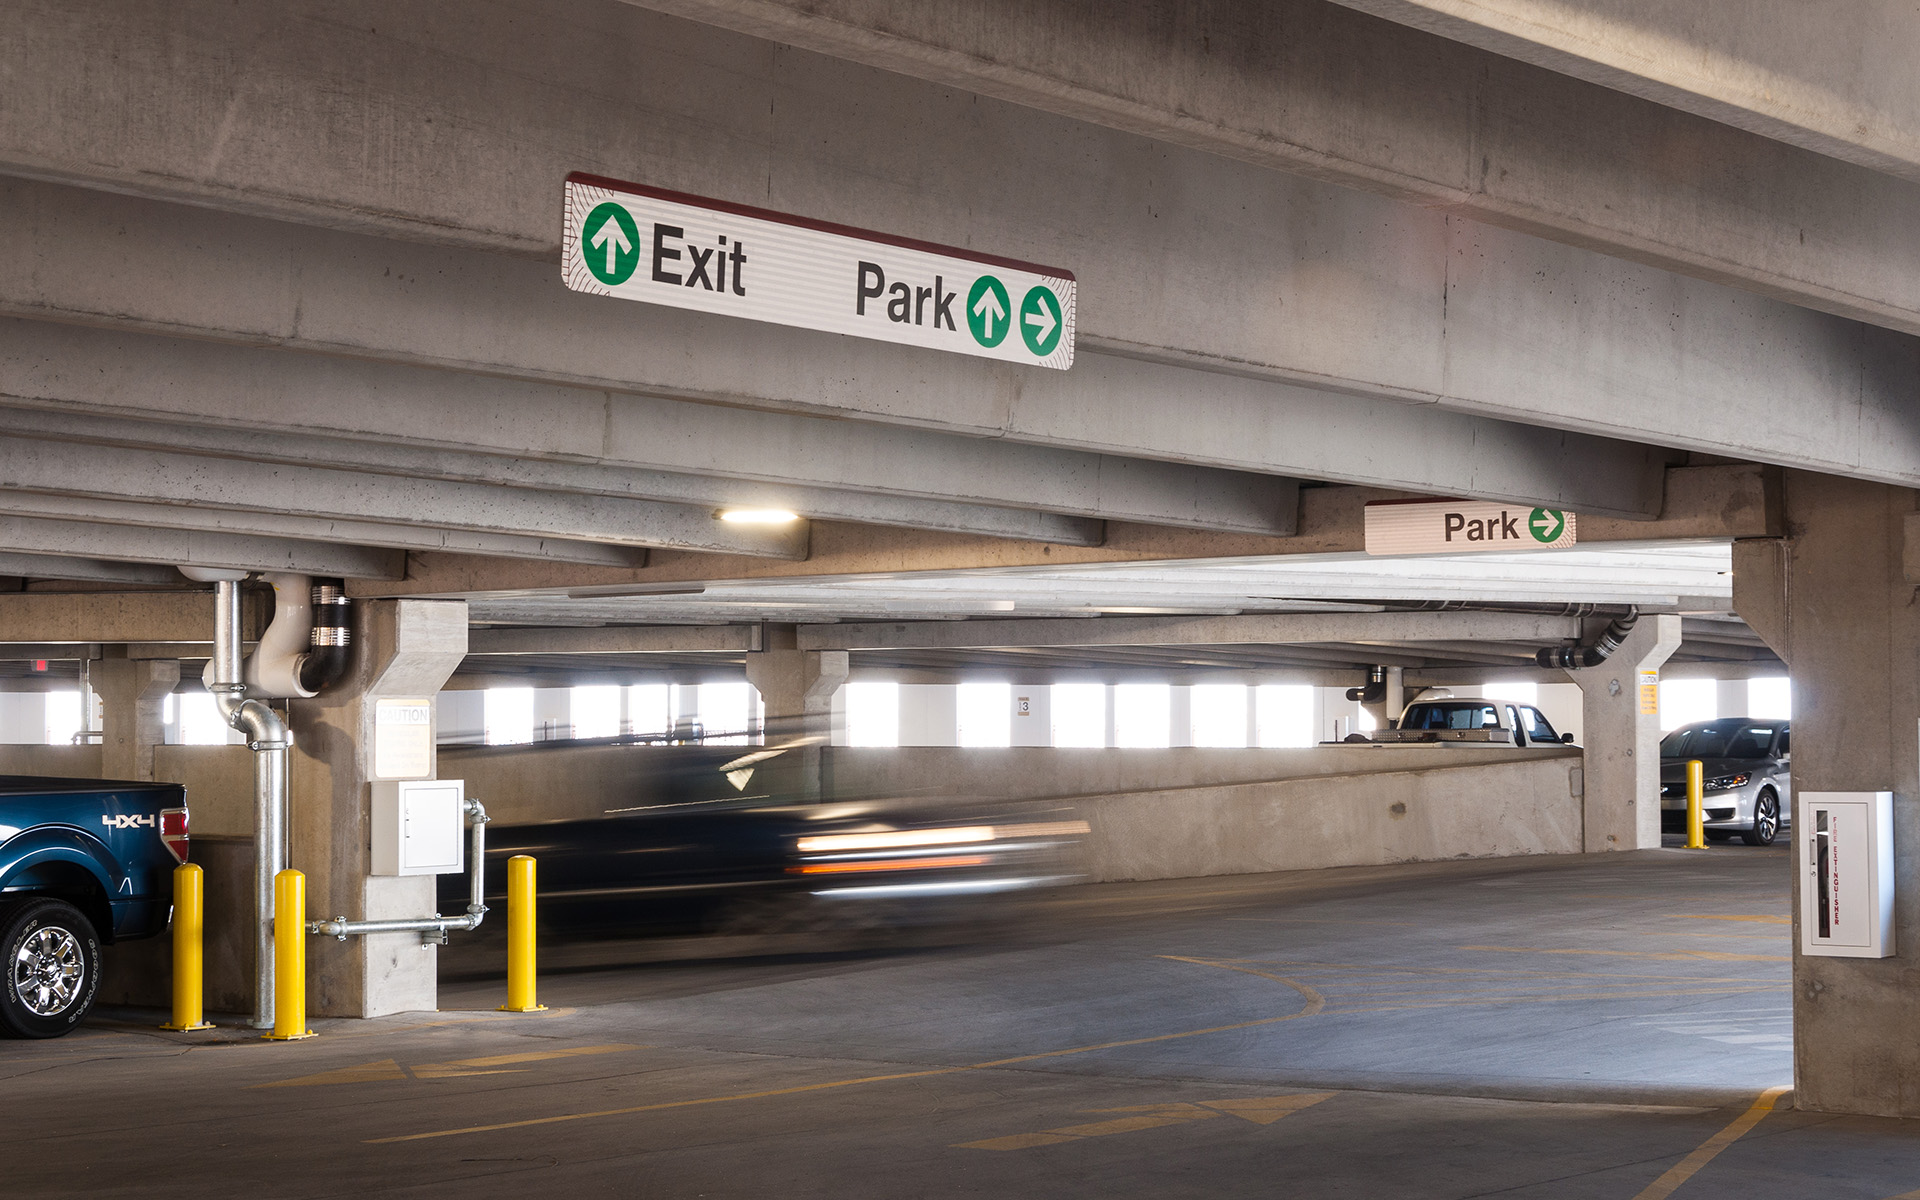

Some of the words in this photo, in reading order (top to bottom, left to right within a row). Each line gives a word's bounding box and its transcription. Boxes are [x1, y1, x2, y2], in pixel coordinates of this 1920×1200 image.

[652, 222, 747, 297] Exit
[856, 260, 957, 331] Park
[1444, 511, 1520, 542] Park
[378, 708, 428, 722] CAUTION
[1022, 701, 1029, 711] 3
[7, 919, 38, 1003] WRANGLER
[69, 938, 99, 1024] GOODYEAR
